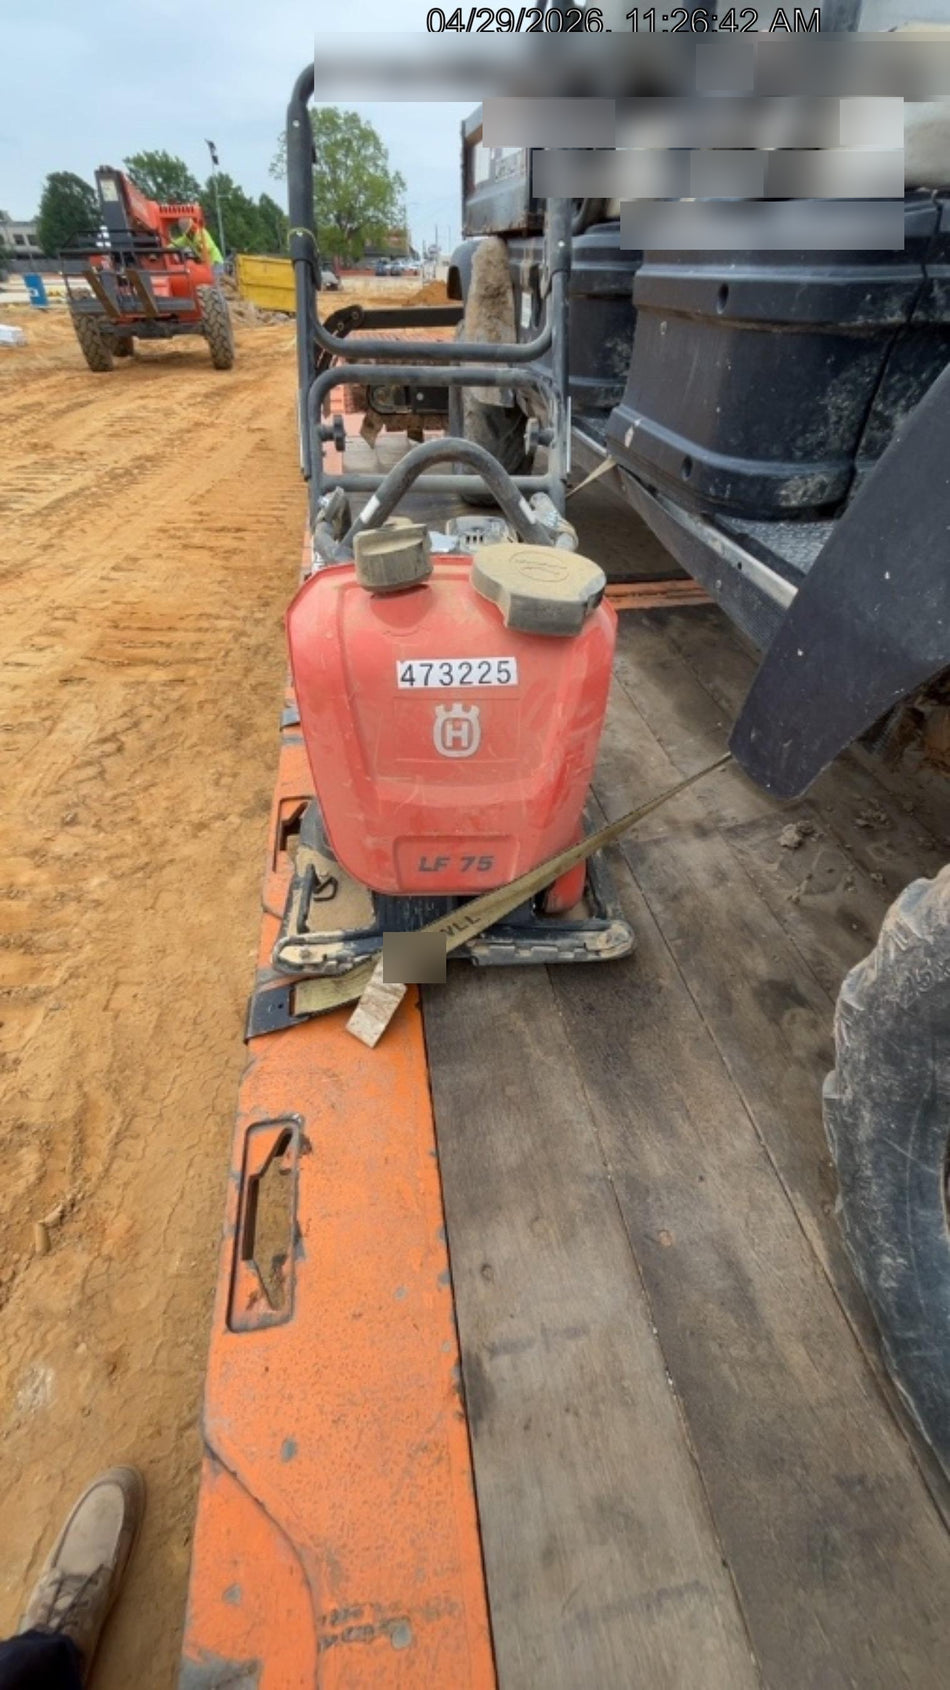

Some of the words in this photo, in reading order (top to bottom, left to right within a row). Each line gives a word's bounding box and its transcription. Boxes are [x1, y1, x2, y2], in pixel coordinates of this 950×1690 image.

[400, 660, 511, 686] 473225
[418, 856, 450, 872] LF
[460, 855, 495, 872] 75
